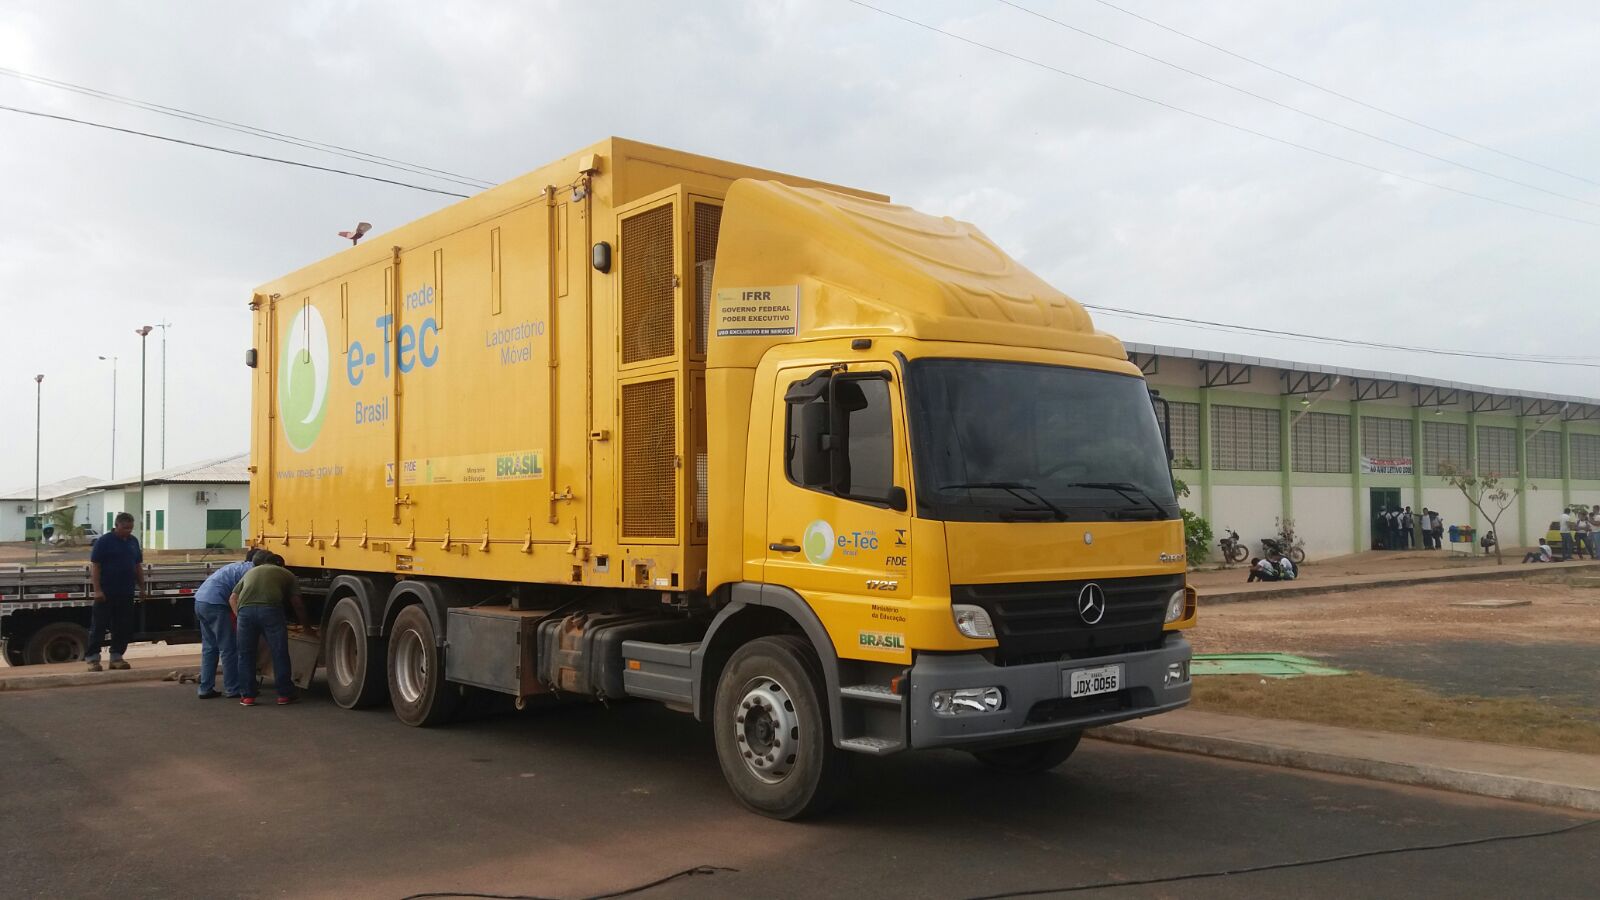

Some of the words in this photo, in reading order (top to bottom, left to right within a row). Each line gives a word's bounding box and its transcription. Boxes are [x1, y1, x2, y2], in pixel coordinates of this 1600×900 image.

[406, 282, 434, 311] rede
[742, 291, 771, 301] IFRR
[748, 314, 790, 322] EXECUTIVO
[486, 318, 545, 348] Laboratório
[347, 313, 440, 387] e-Tec
[501, 342, 531, 367] Móvel
[355, 395, 389, 424] Brasil
[496, 454, 542, 477] BRASIL
[837, 532, 879, 550] e-Tec
[885, 556, 908, 566] FNDE
[866, 580, 898, 591] 1725
[871, 604, 899, 613] Ministério
[880, 613, 906, 622] Educação
[859, 633, 905, 649] BRASIL
